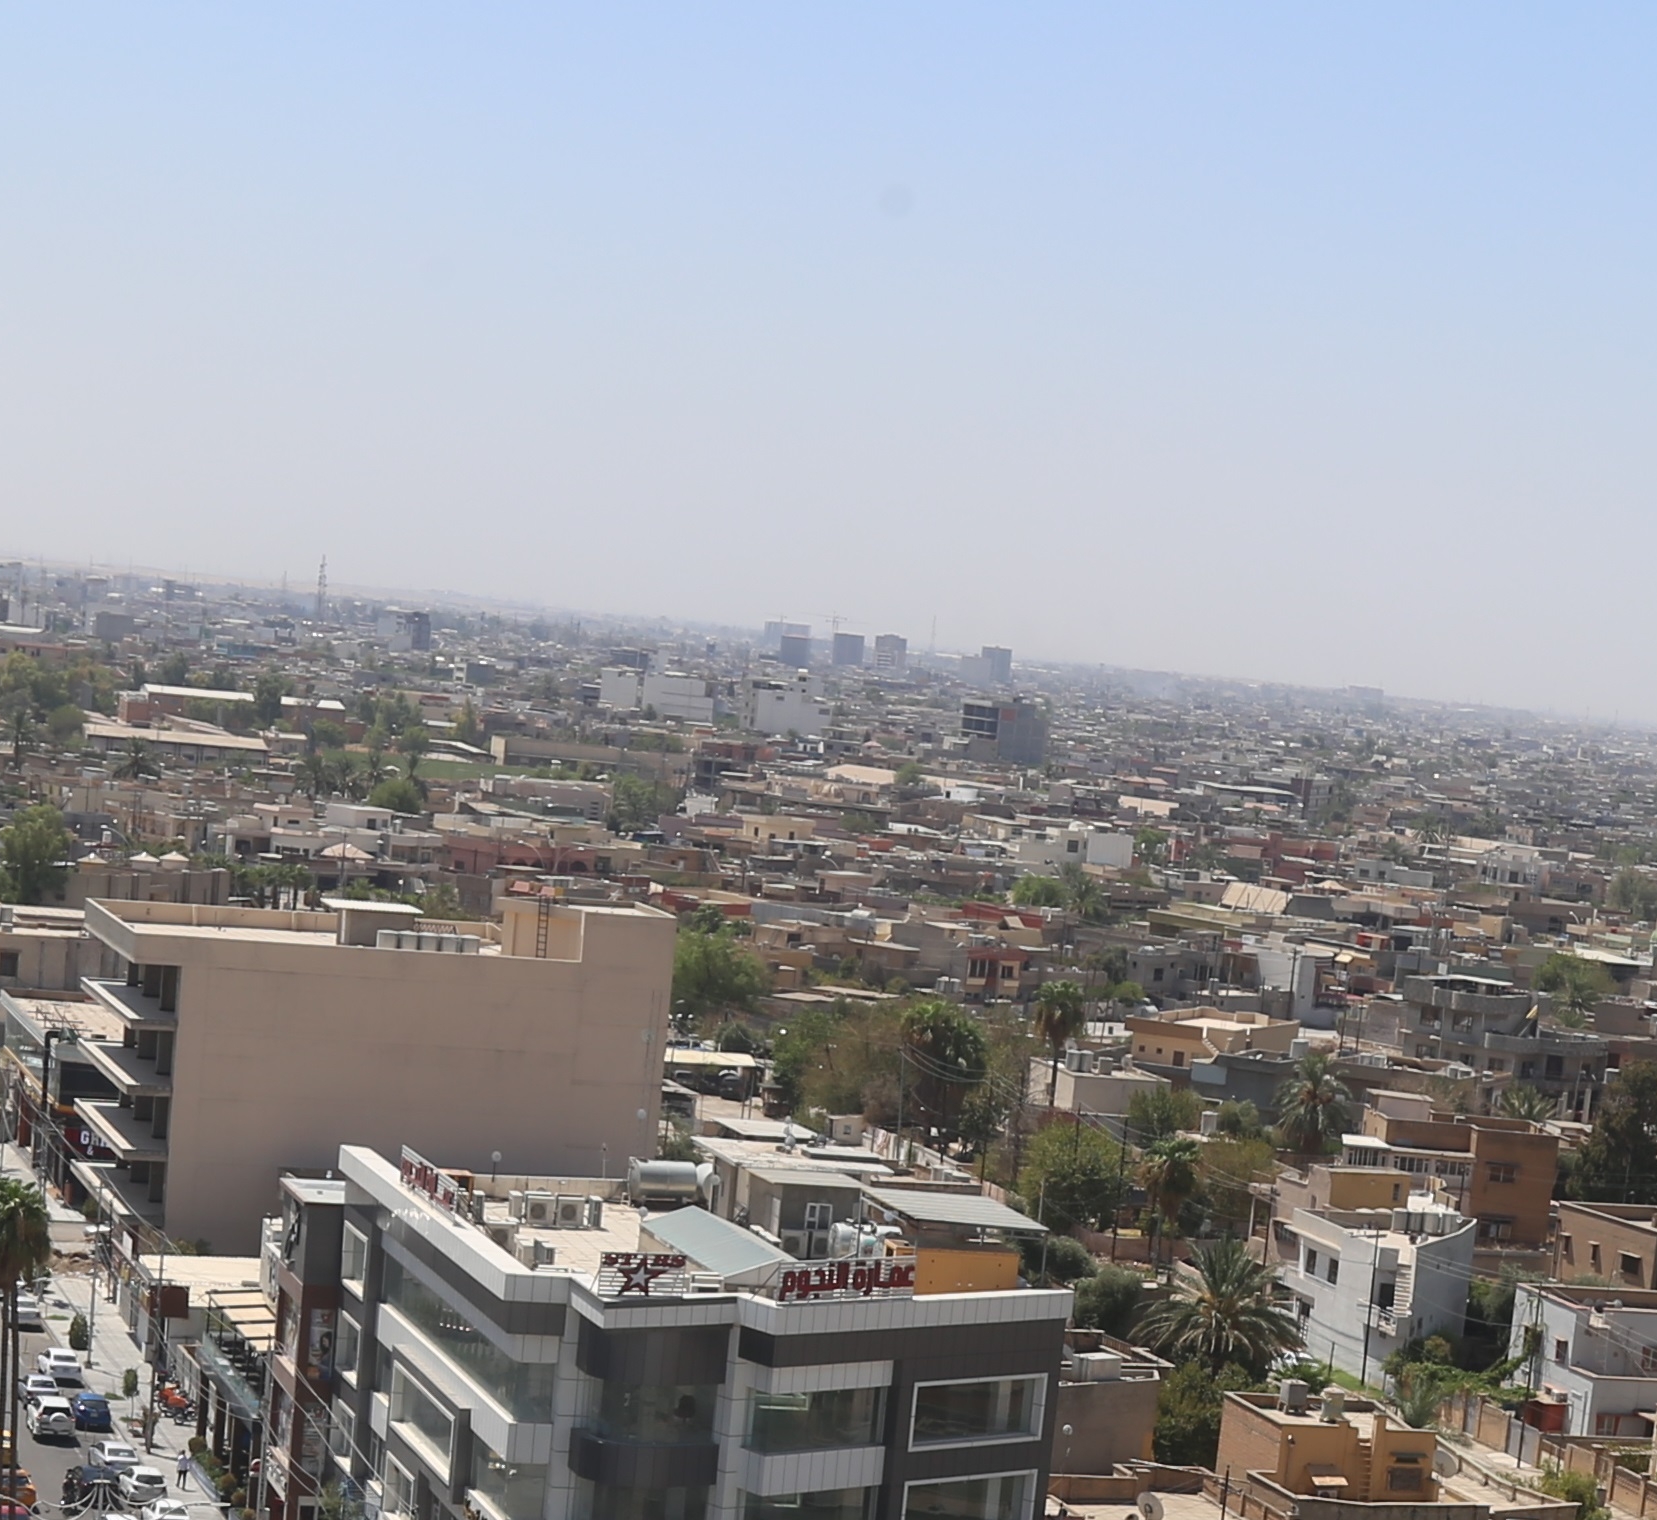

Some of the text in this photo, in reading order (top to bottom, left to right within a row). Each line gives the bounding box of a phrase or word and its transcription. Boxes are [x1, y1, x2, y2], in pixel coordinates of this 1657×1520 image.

[601, 1252, 687, 1269] STARS
[779, 1258, 915, 1302] عمارة النجوم
